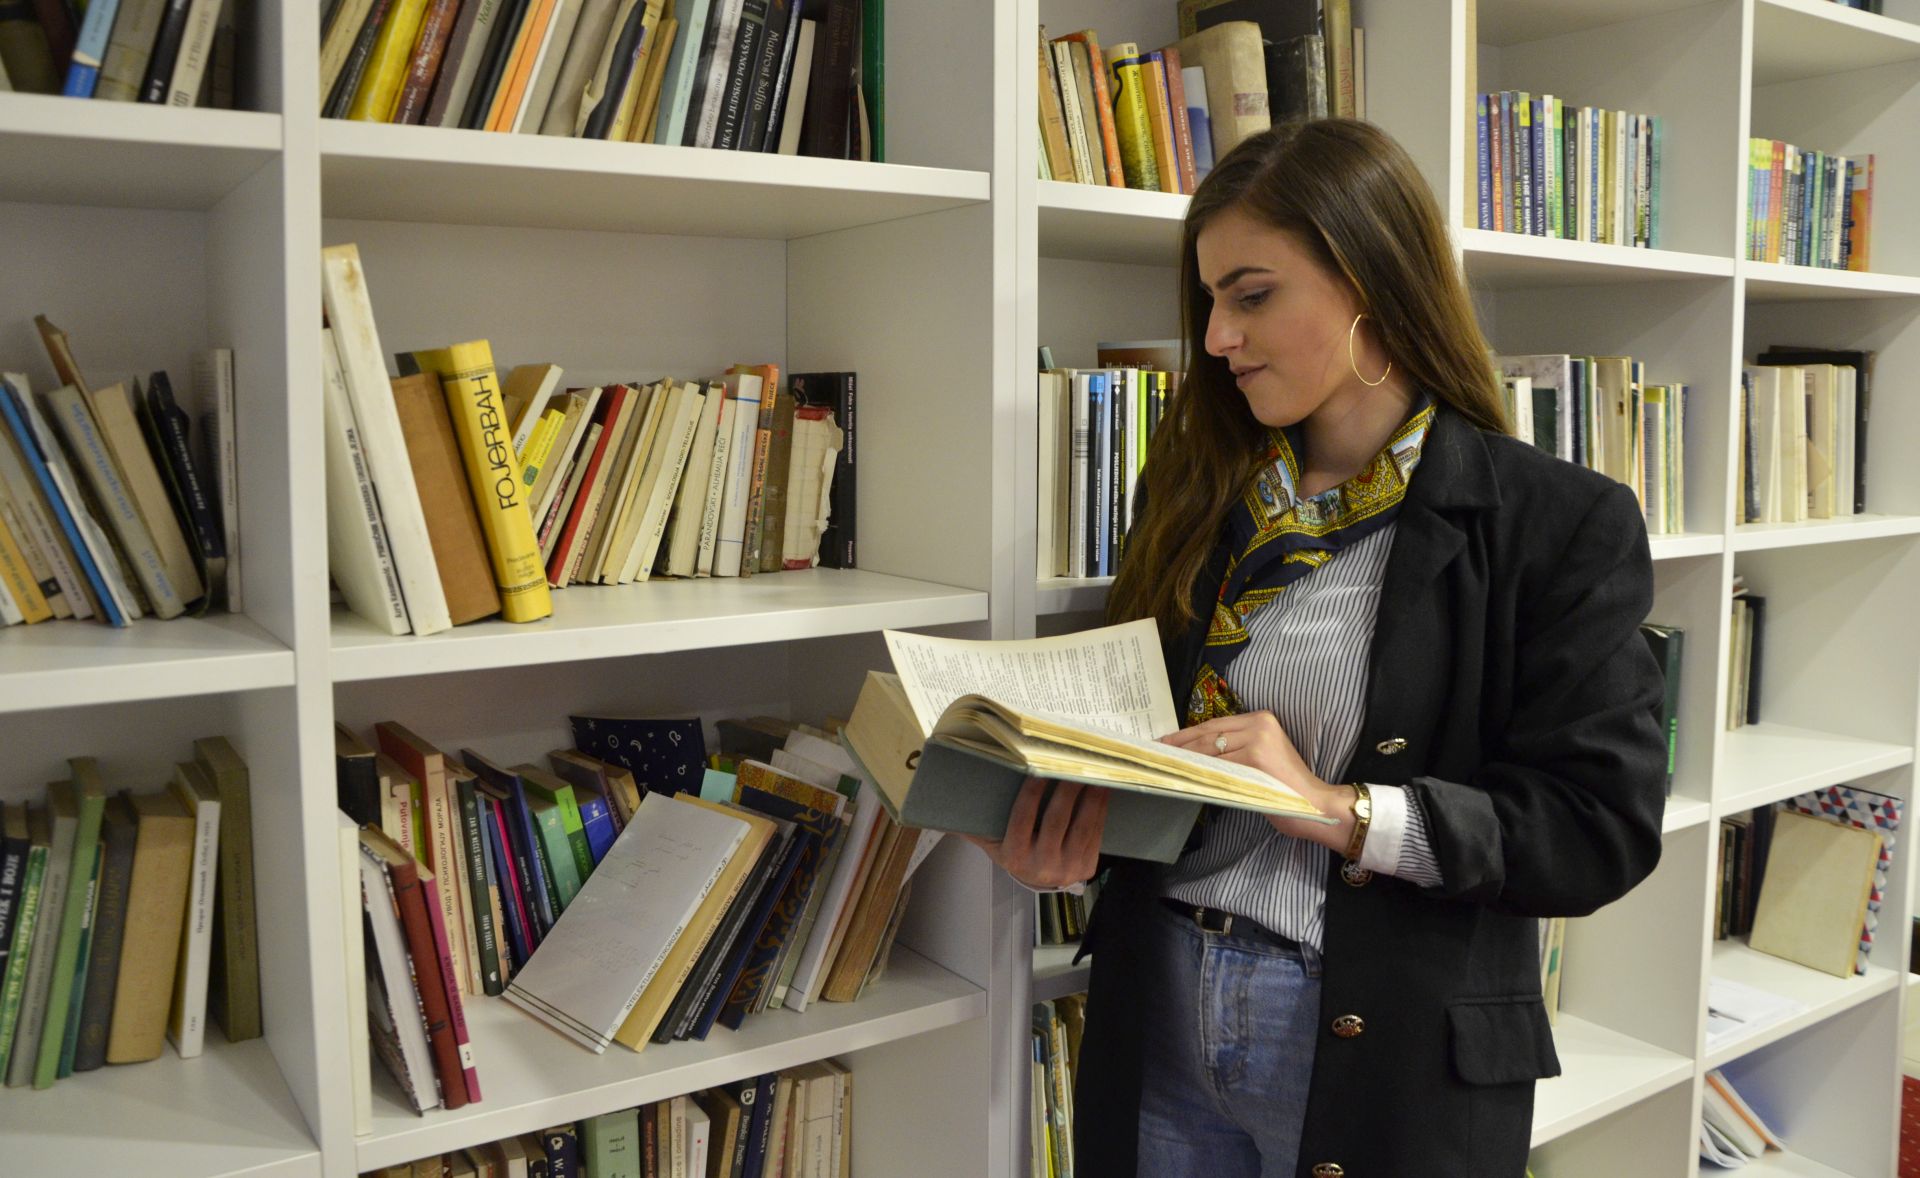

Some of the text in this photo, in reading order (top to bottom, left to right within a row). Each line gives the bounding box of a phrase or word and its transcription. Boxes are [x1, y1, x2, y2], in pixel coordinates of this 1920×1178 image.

[759, 30, 779, 77] Mudrost
[721, 128, 732, 148] UKA
[727, 77, 743, 119] LJUDSKO
[735, 21, 755, 75] PONAŠANJE
[1494, 204, 1502, 230] akvim
[701, 496, 717, 550] PARANDOVSKI
[711, 455, 723, 490] ALHEMIJA
[398, 801, 411, 848] Putovanje
[435, 797, 443, 828] МОРАЛА
[3, 853, 19, 885] BOJE
[444, 895, 452, 915] УВОД
[625, 924, 683, 1011] INTELEKTUALNI TERORIZAM
[674, 1116, 682, 1153] omladine
